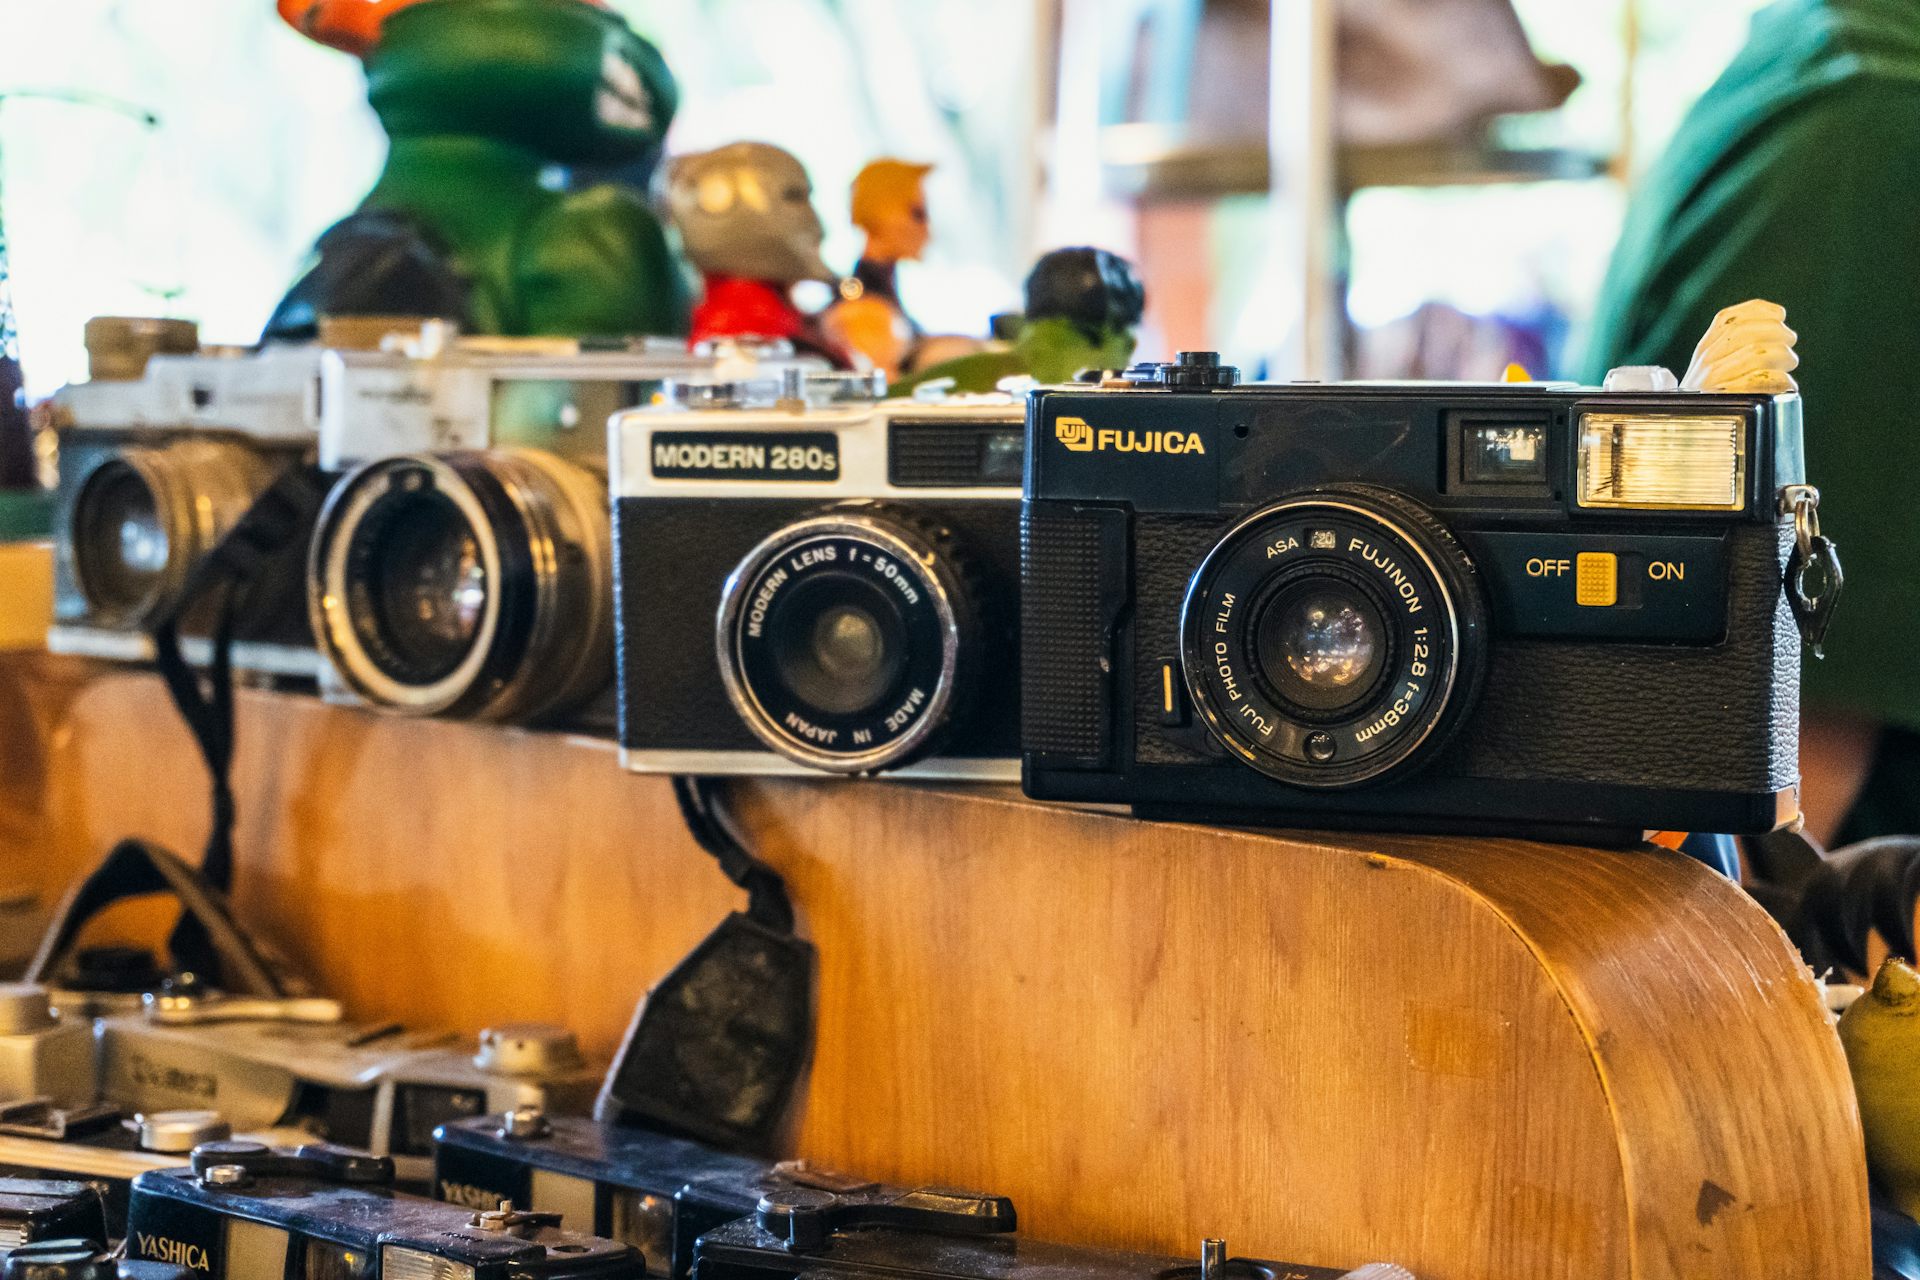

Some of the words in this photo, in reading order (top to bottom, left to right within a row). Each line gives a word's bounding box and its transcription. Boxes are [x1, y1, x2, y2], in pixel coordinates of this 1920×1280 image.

[655, 443, 765, 470] MODERN
[770, 445, 836, 472] 280s
[1098, 429, 1205, 454] FUJICA
[1266, 537, 1299, 559] ASA
[1525, 557, 1571, 577] OFF
[1647, 560, 1685, 581] ON
[748, 568, 789, 638] MODERN
[790, 545, 837, 572] LENS
[1348, 537, 1423, 614] FUJINON
[1411, 626, 1429, 677] 1:2.8
[1215, 592, 1237, 633] FILM
[1214, 642, 1242, 701] PHOTO
[884, 687, 925, 733] MADE
[1239, 704, 1274, 736] FUJI
[785, 711, 838, 744] JAPAN
[852, 728, 872, 744] IN
[136, 1231, 210, 1272] YASHICA
